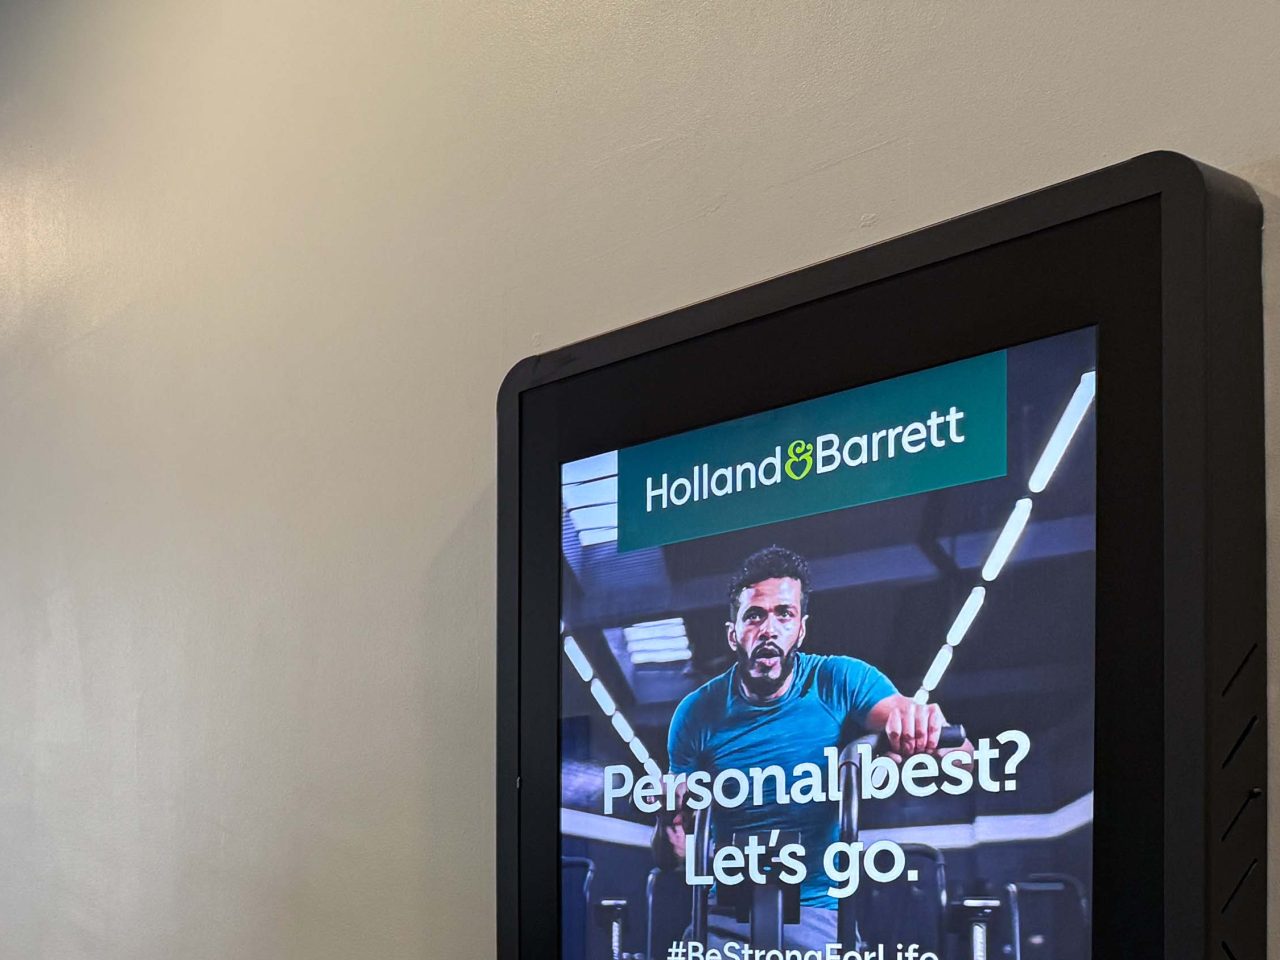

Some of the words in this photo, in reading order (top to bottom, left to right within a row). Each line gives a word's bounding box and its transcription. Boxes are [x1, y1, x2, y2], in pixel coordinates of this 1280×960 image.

[645, 406, 965, 512] Holland&Barrett
[602, 746, 842, 815] Personal
[857, 730, 1031, 799] best?
[685, 829, 807, 887] Let's
[823, 839, 919, 899] go.
